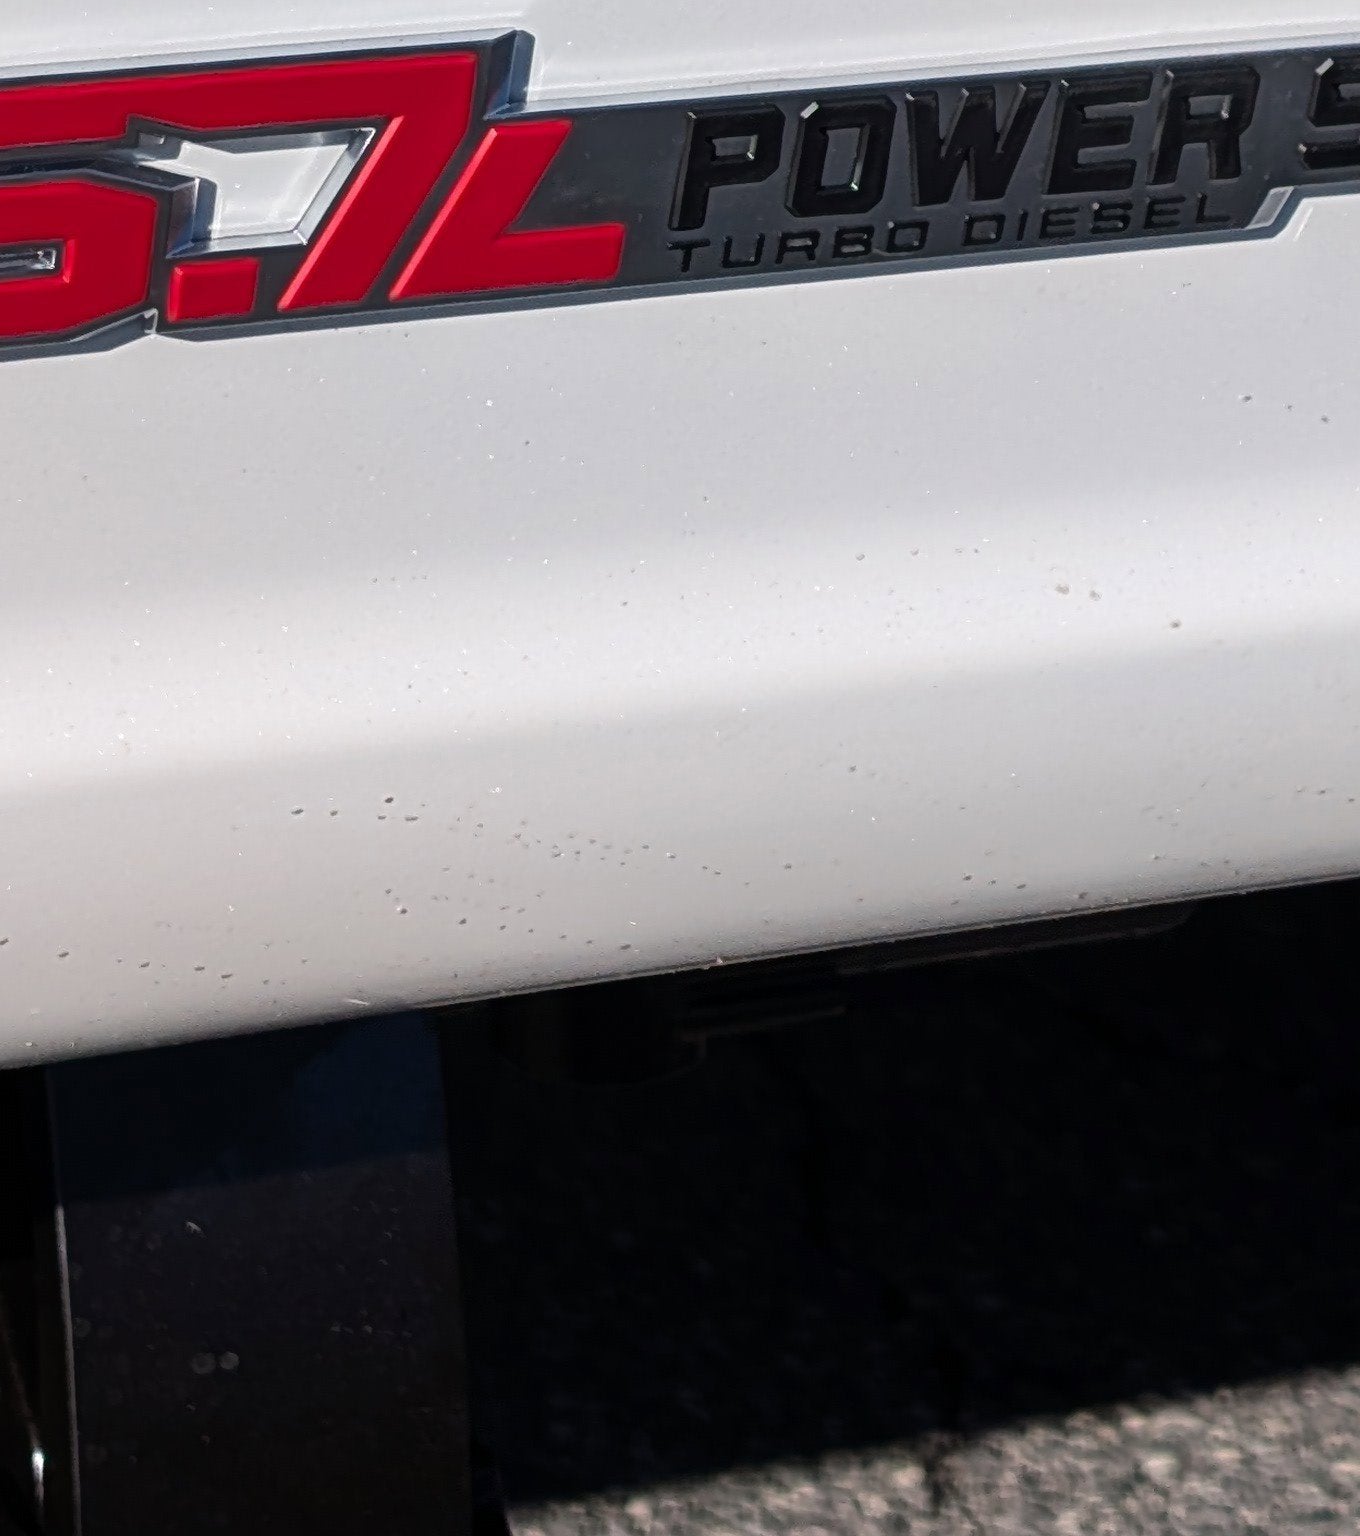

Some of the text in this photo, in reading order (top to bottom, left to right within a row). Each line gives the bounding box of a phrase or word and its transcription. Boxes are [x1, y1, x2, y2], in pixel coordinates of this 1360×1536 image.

[668, 67, 1258, 232] POWER
[667, 190, 1235, 274] TURBO DIESEL
